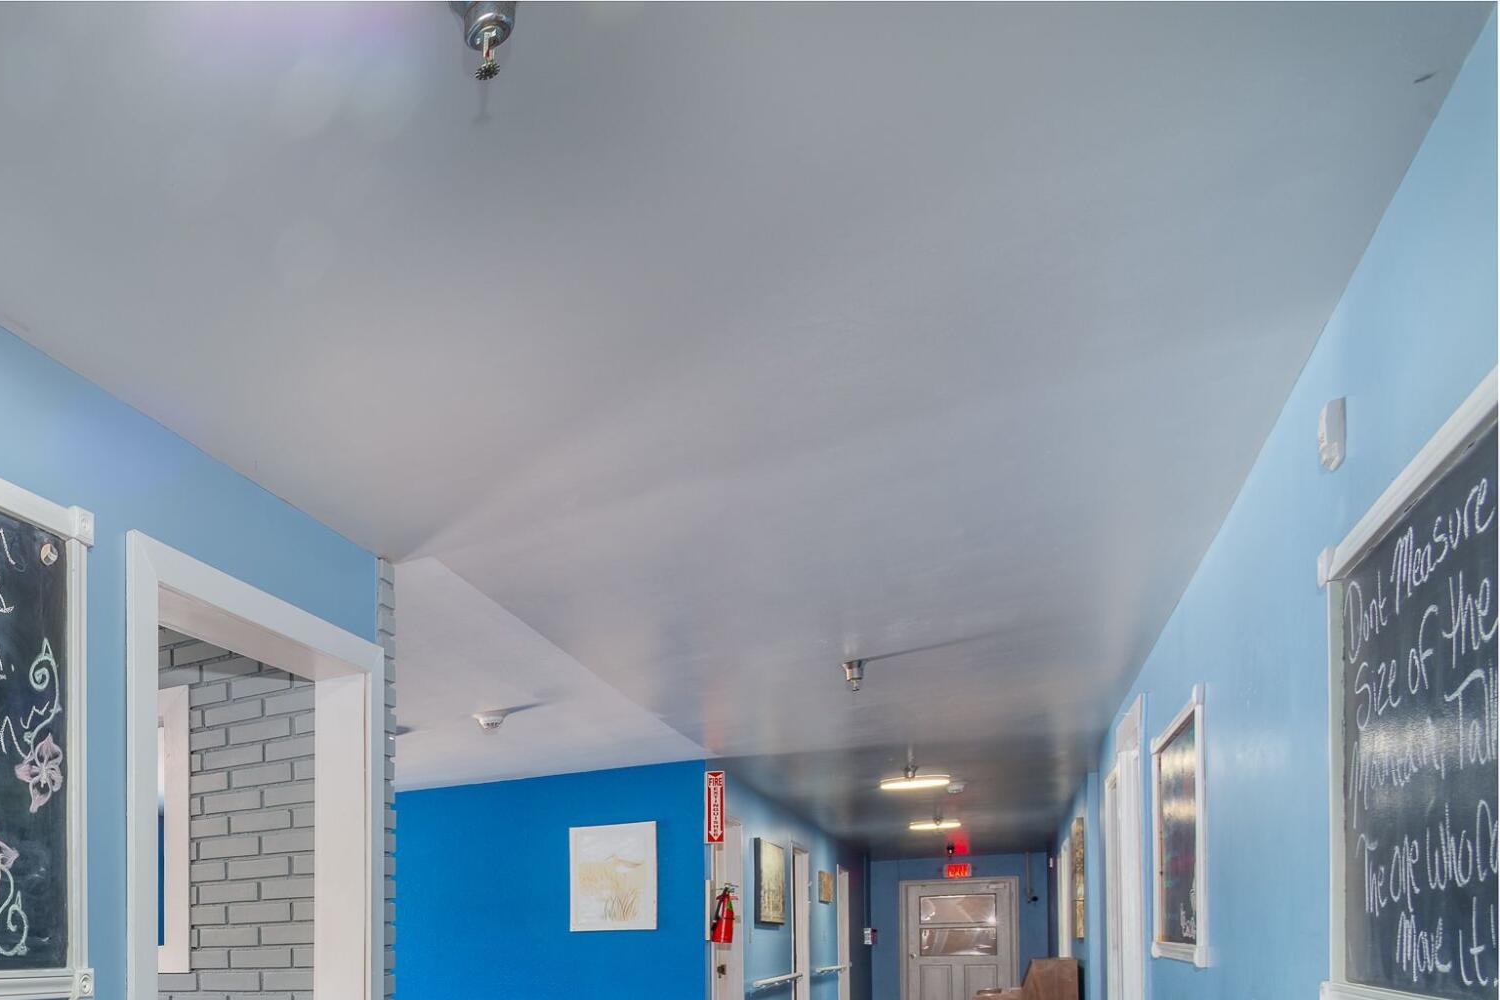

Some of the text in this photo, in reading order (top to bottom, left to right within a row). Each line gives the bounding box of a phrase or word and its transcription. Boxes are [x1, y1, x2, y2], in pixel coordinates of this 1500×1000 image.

[1390, 477, 1497, 617] Measure
[1407, 603, 1438, 695] of
[708, 777, 723, 787] FIRE
